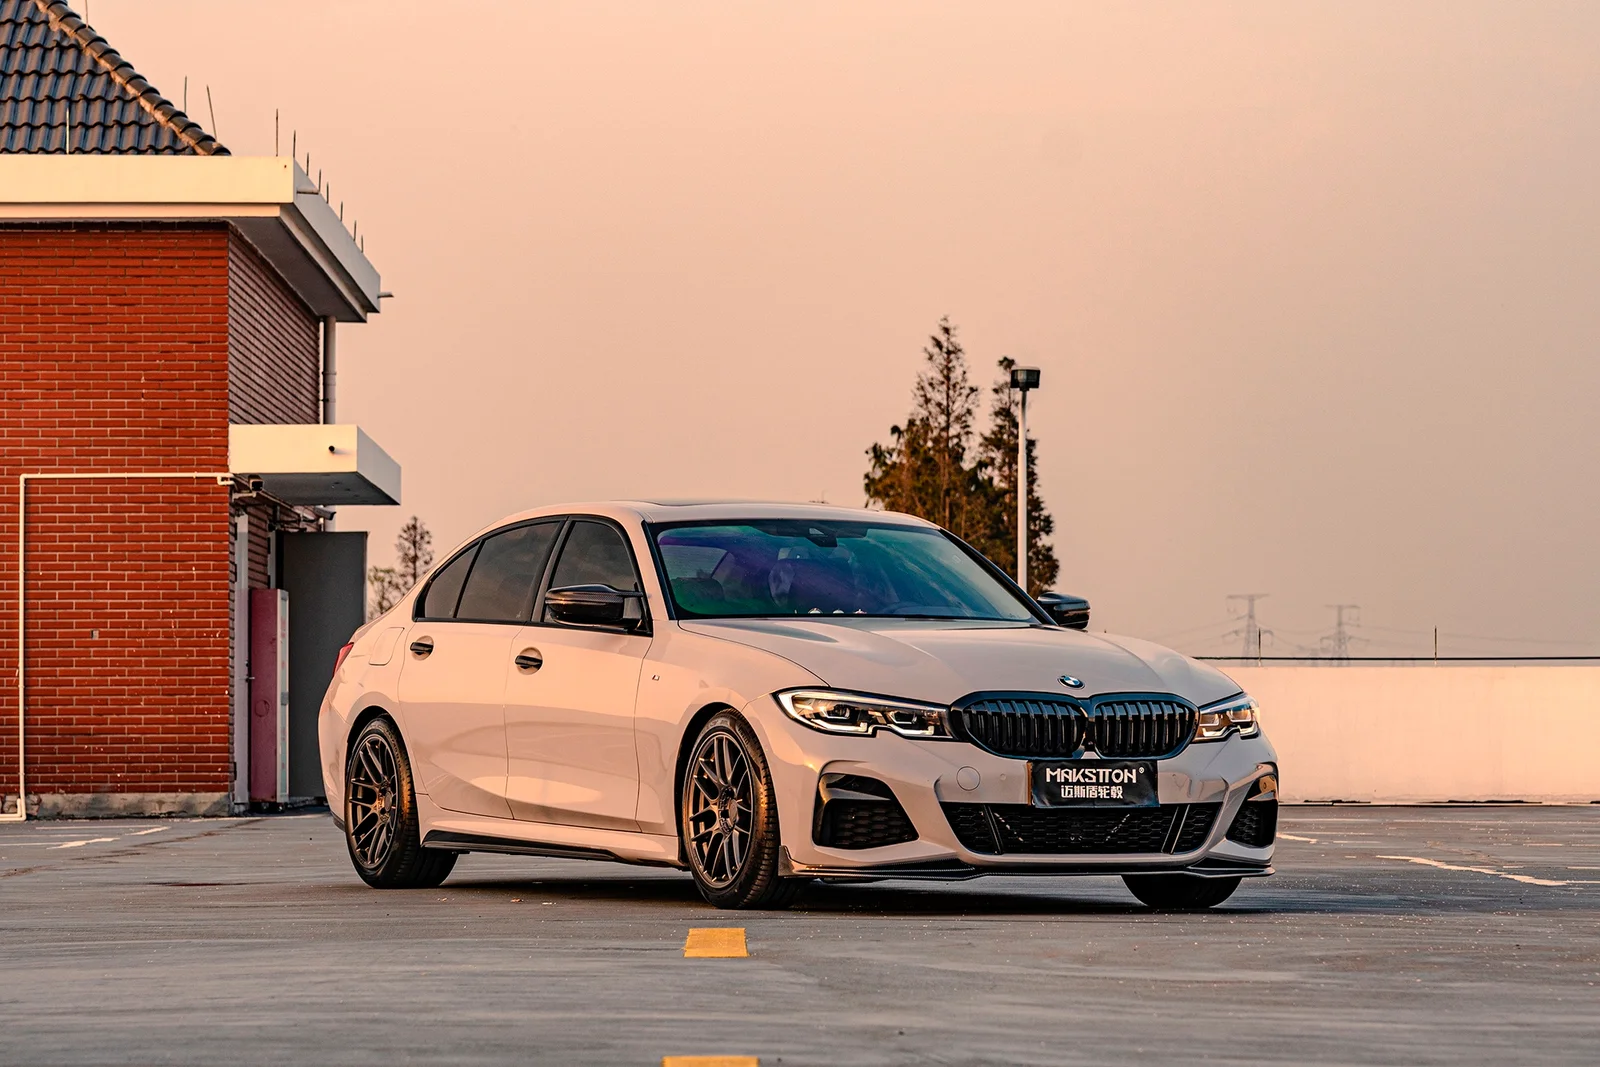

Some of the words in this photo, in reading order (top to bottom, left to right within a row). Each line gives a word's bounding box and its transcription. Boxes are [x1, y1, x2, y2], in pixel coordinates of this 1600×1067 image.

[1060, 785, 1123, 799] 迈斯盾轮毂
